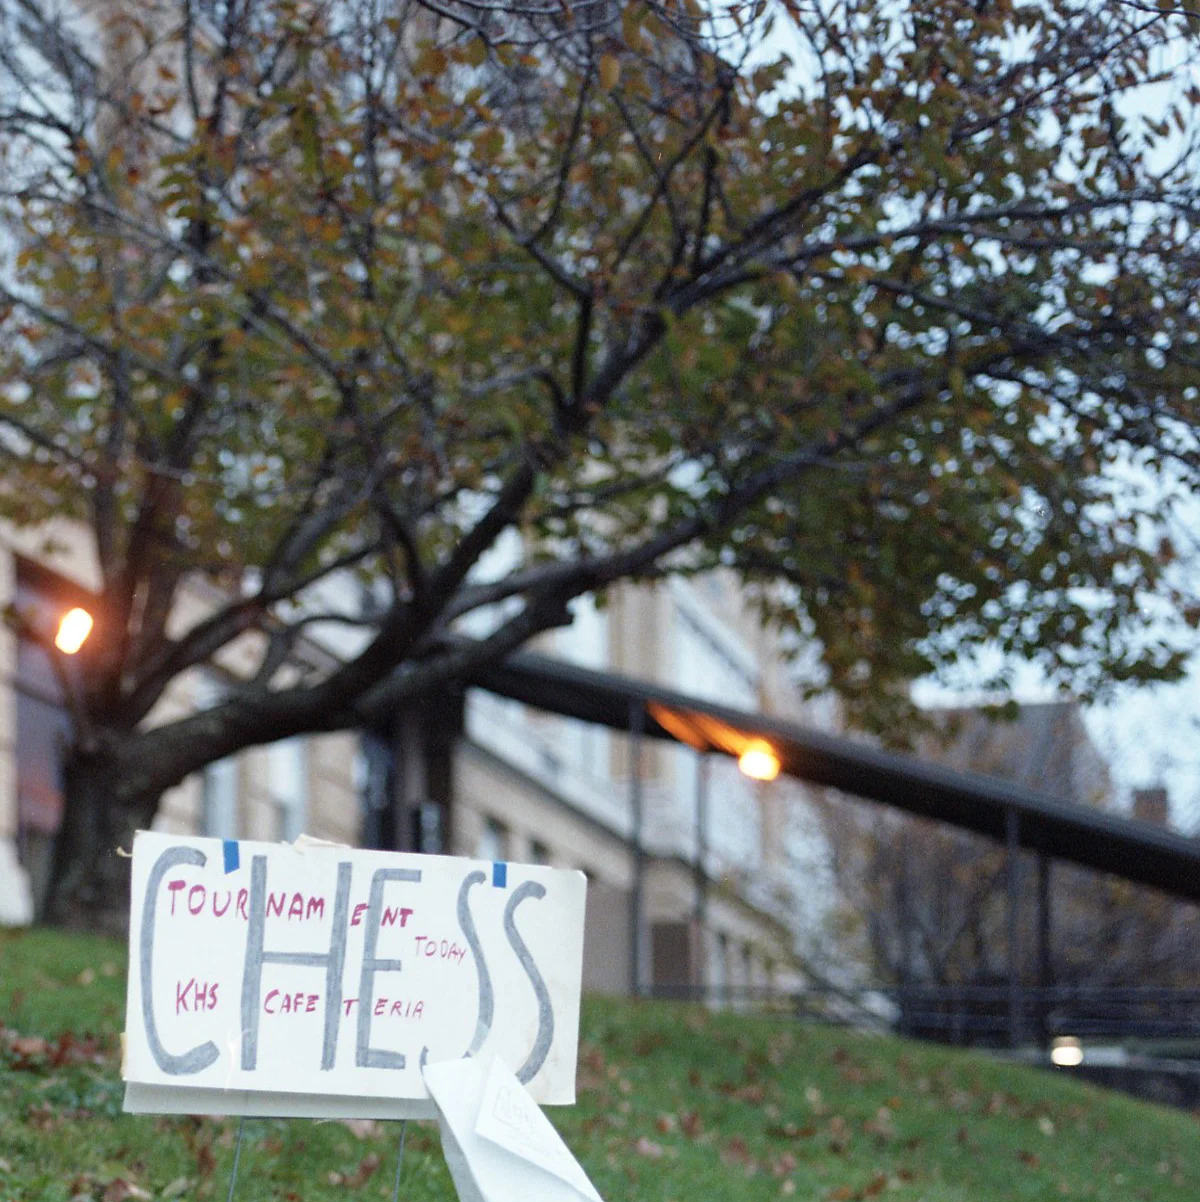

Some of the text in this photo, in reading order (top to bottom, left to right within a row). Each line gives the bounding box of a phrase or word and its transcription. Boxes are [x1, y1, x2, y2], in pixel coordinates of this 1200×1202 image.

[168, 880, 414, 928] TOURNAMENT
[140, 846, 554, 1086] CHESS
[415, 936, 467, 964] TODAY
[175, 978, 424, 1019] KHS CAFETERIA
